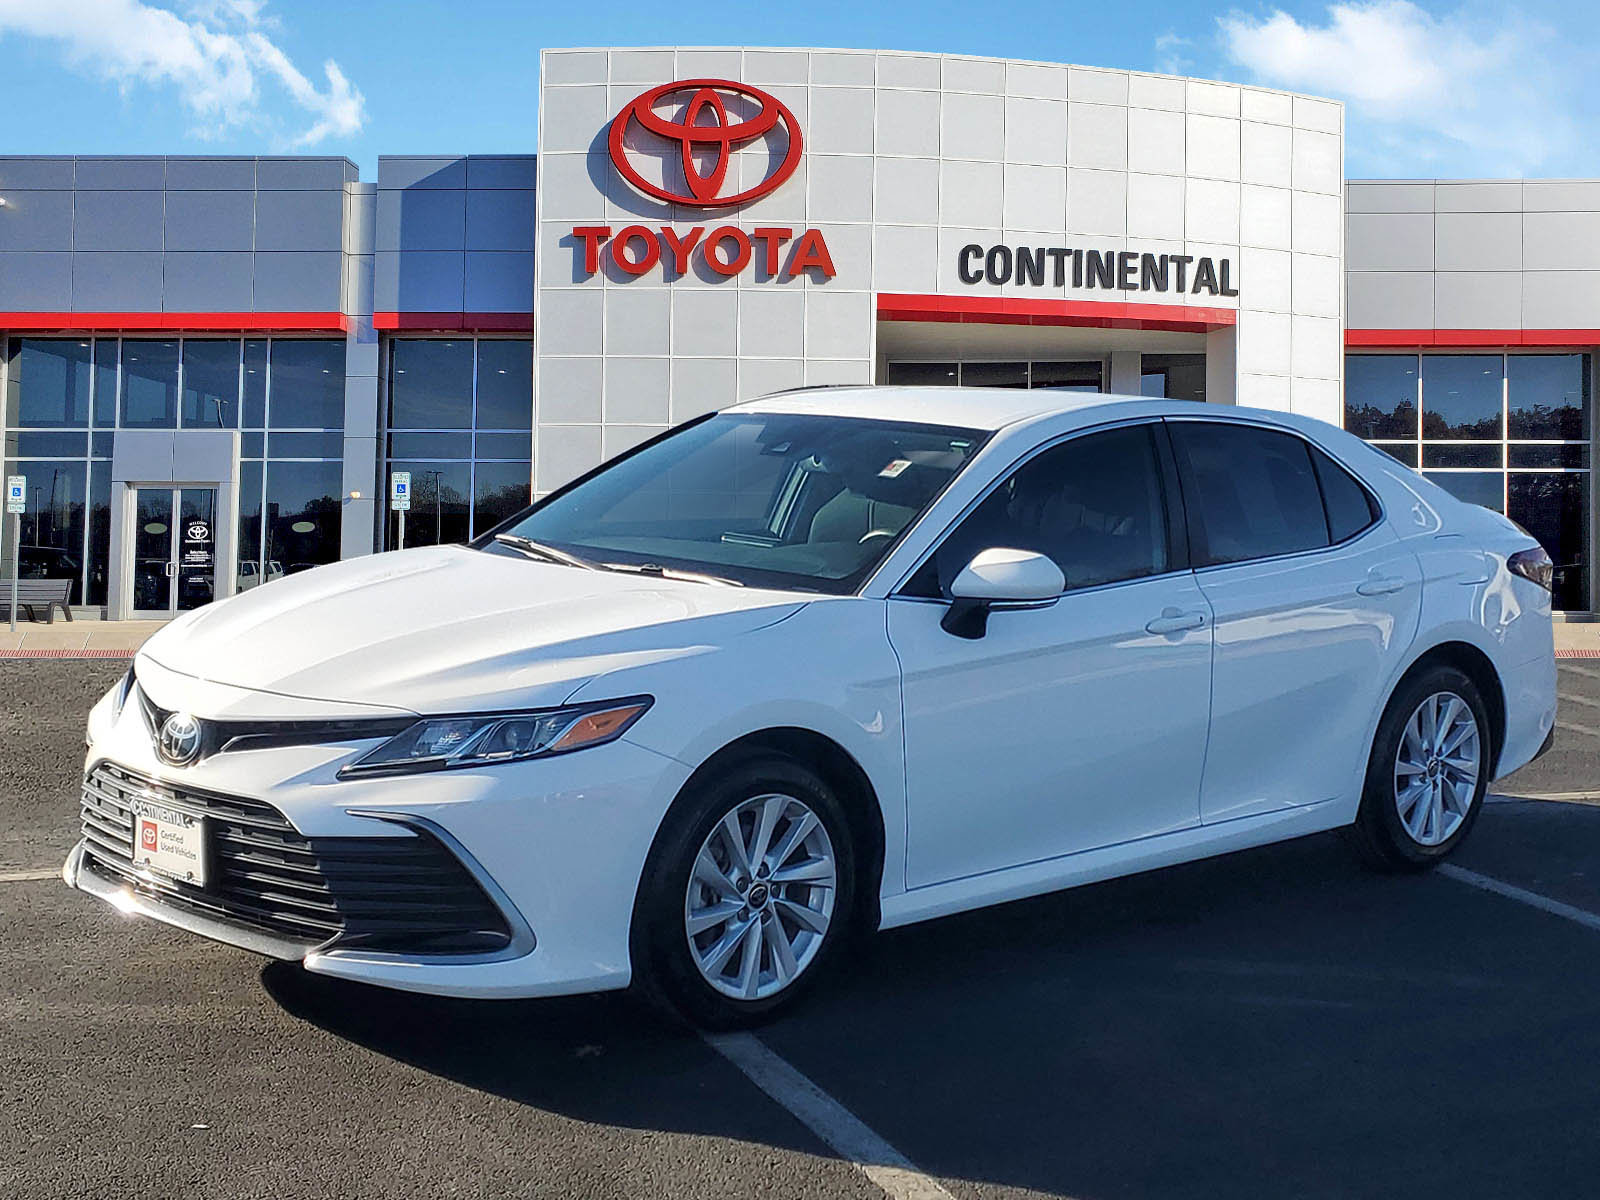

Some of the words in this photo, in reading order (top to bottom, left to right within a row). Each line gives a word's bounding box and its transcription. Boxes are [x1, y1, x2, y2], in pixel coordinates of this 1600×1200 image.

[573, 225, 837, 276] TOYOTA
[958, 244, 1239, 296] CONTINENTAL
[160, 829, 184, 845] Certified
[160, 841, 174, 853] Used
[175, 845, 197, 860] Vehicles
